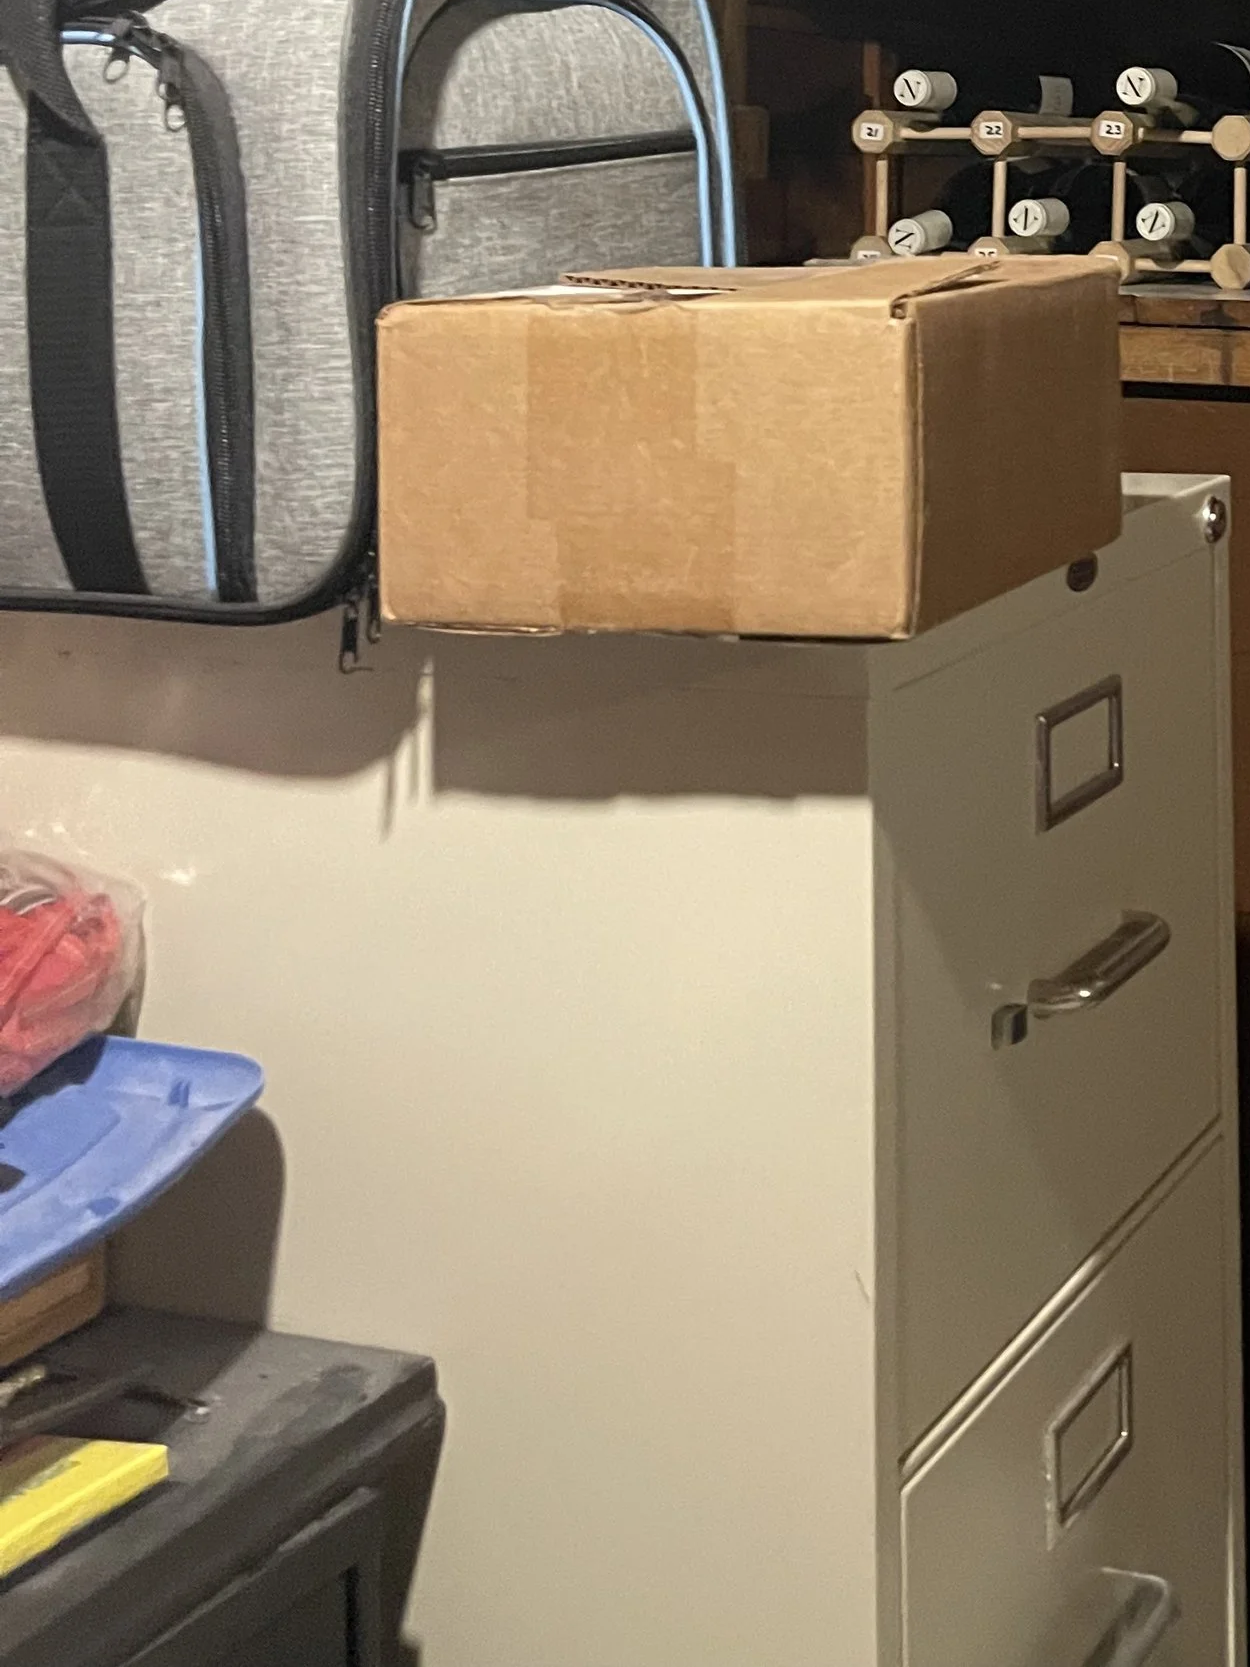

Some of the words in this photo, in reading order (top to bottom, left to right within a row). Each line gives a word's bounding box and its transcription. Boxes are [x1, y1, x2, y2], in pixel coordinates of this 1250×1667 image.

[866, 127, 879, 137] 21
[985, 125, 1002, 136] 22
[1106, 124, 1122, 135] 23
